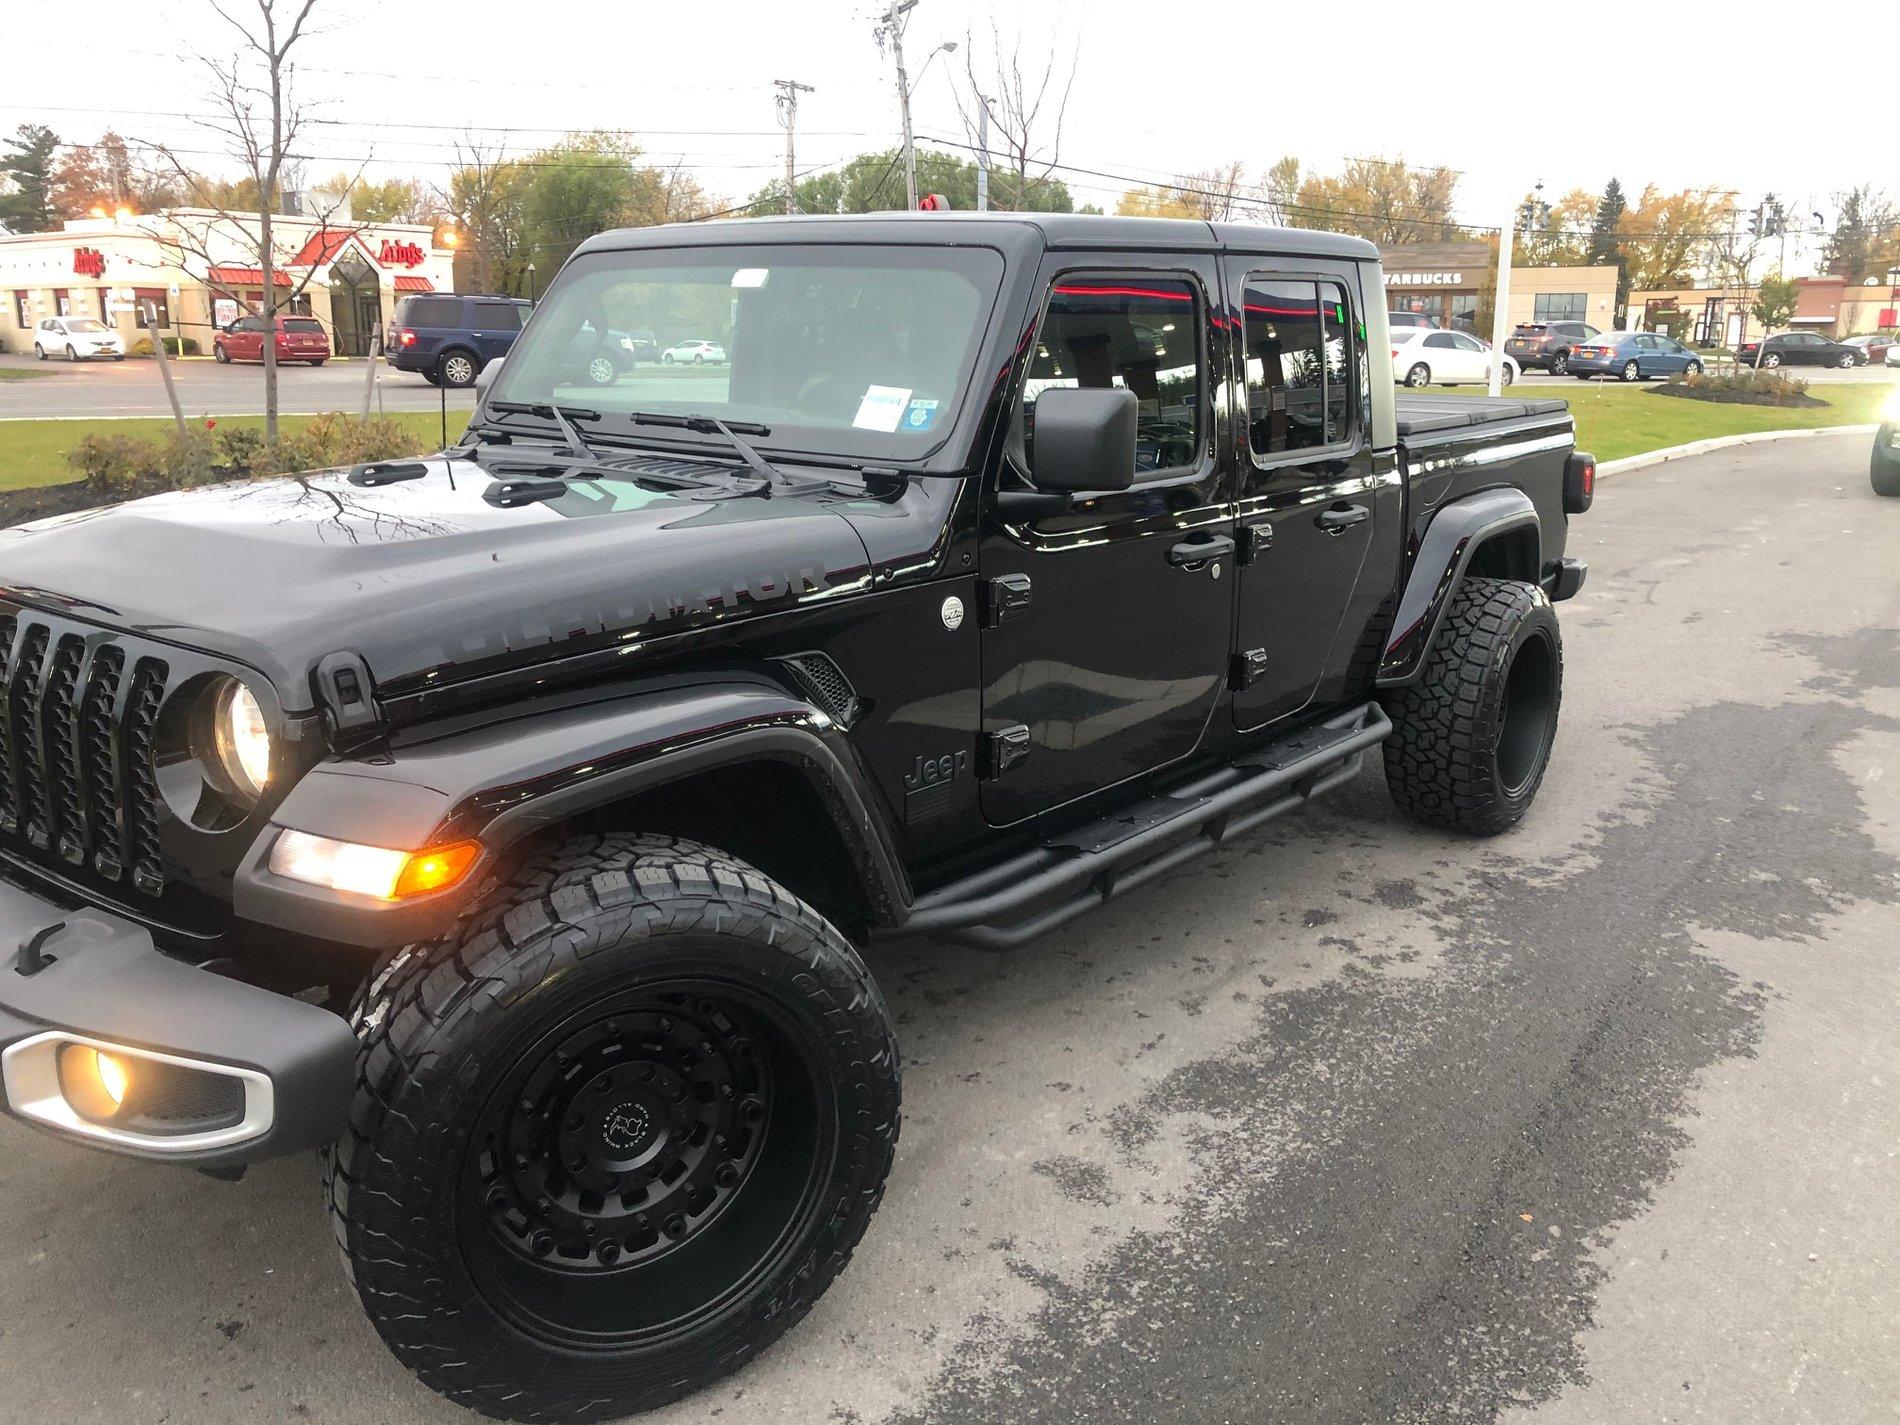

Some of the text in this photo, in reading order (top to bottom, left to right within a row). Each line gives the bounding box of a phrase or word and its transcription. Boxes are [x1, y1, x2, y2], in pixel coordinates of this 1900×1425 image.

[1382, 272, 1463, 285] TARBUCKS
[903, 749, 968, 790] Jeep
[634, 1103, 650, 1119] HARD
[602, 1131, 647, 1149] BLACK RHINO
